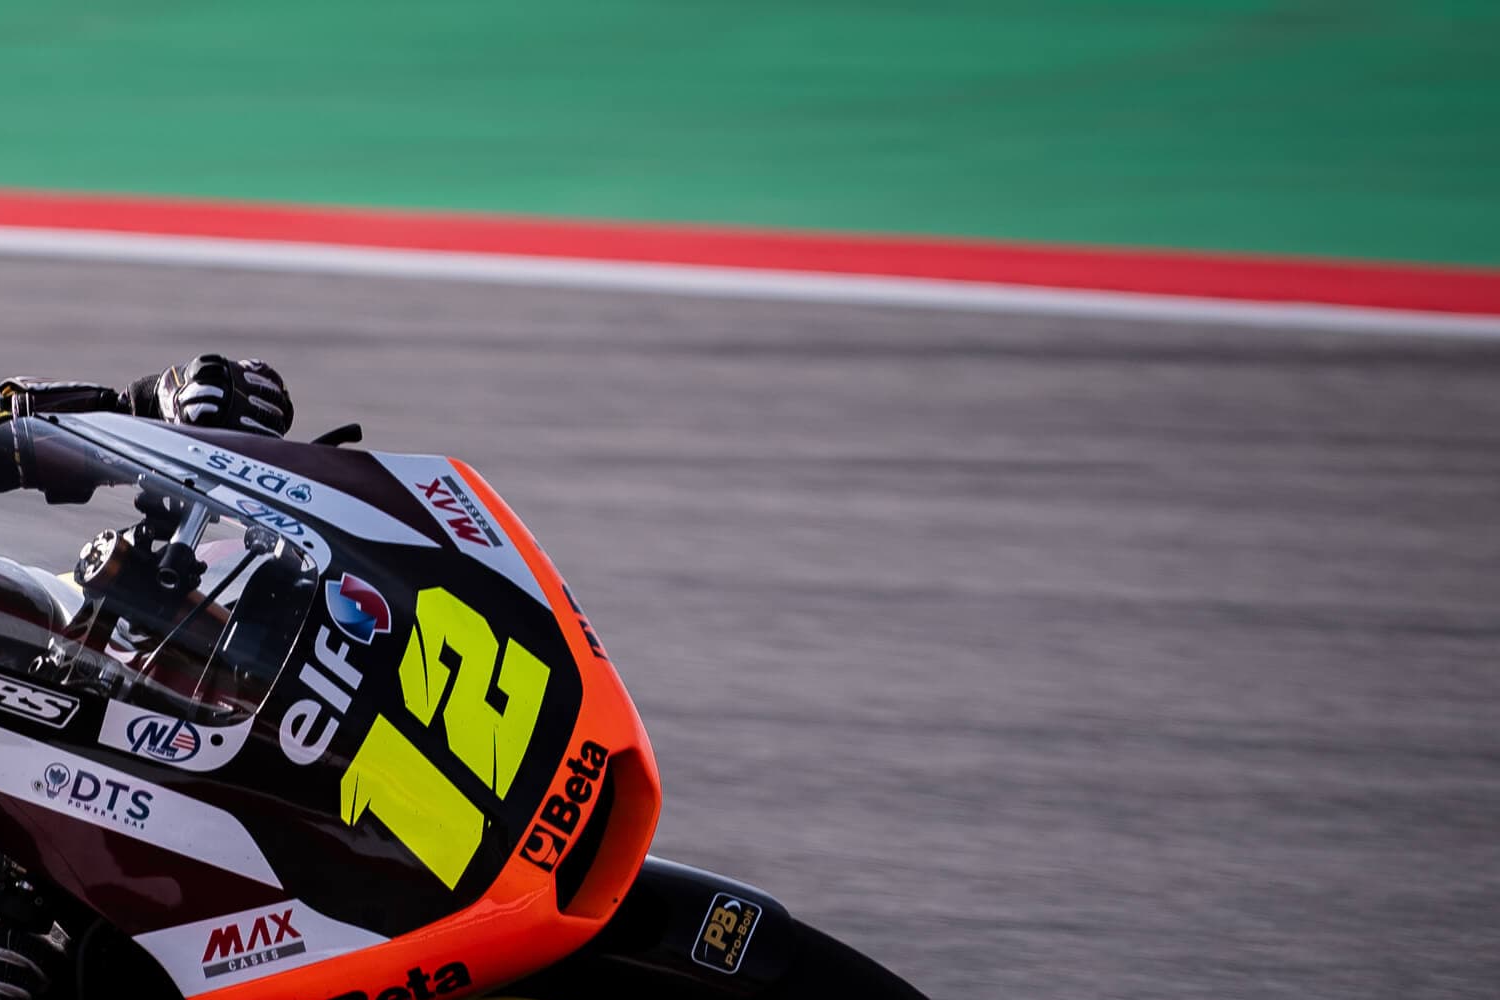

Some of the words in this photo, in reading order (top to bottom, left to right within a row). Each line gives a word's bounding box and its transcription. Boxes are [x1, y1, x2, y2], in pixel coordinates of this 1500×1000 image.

[206, 454, 288, 494] DTS
[415, 477, 492, 548] MAX
[278, 624, 364, 766] elf
[339, 586, 551, 891] 12
[67, 799, 107, 818] POWER
[70, 769, 155, 822] DTS
[539, 739, 610, 846] Beta
[202, 908, 302, 963] MAX
[703, 905, 740, 953] PB
[723, 907, 756, 968] Pro-Bolt
[228, 950, 280, 972] CASES
